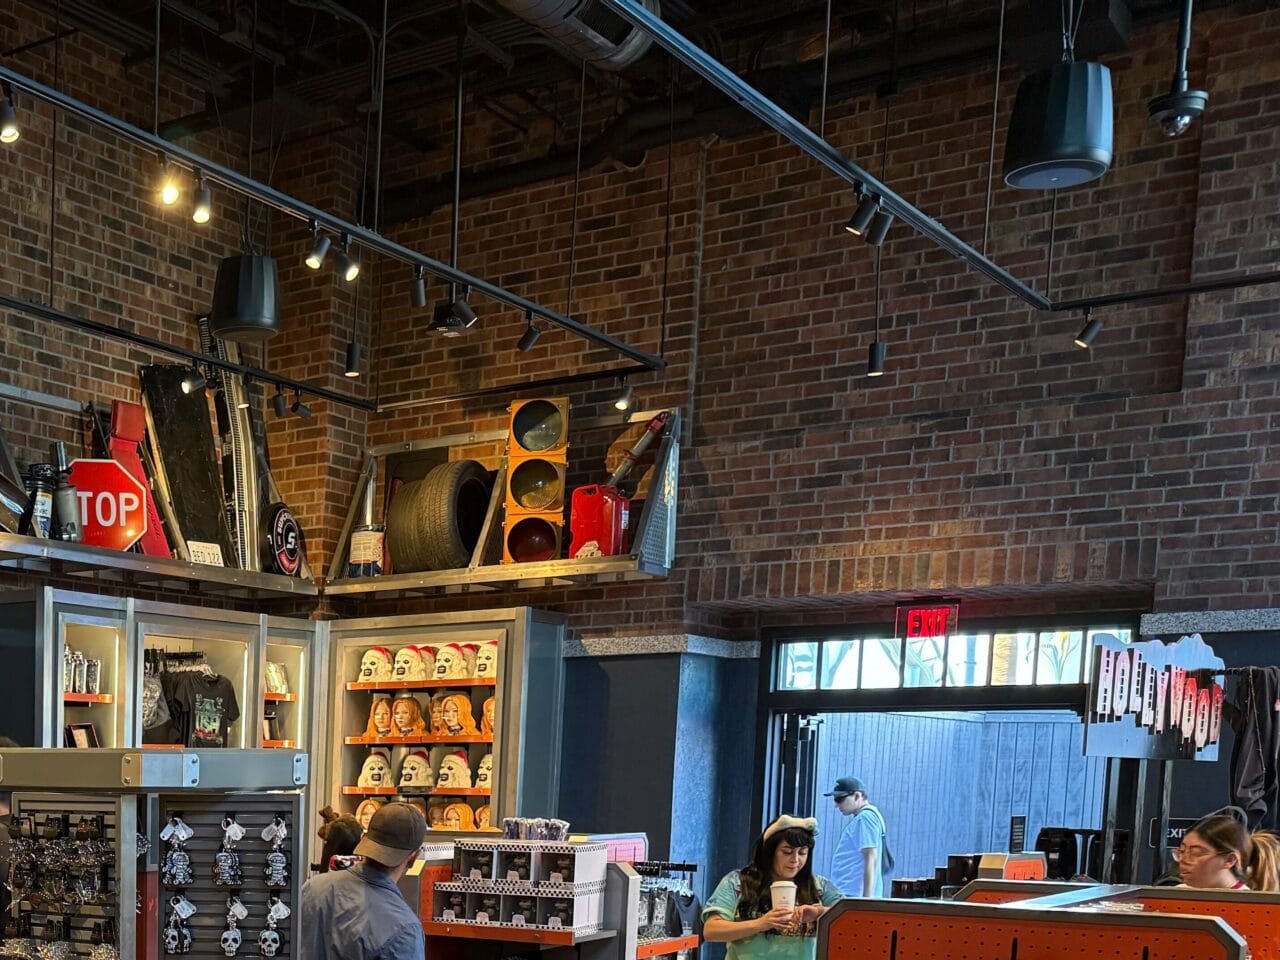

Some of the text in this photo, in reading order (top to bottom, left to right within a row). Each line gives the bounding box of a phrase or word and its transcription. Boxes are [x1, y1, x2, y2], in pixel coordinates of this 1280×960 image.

[77, 491, 140, 527] TOP
[907, 608, 950, 638] EXIT
[1097, 645, 1224, 750] HOLLYWOOD
